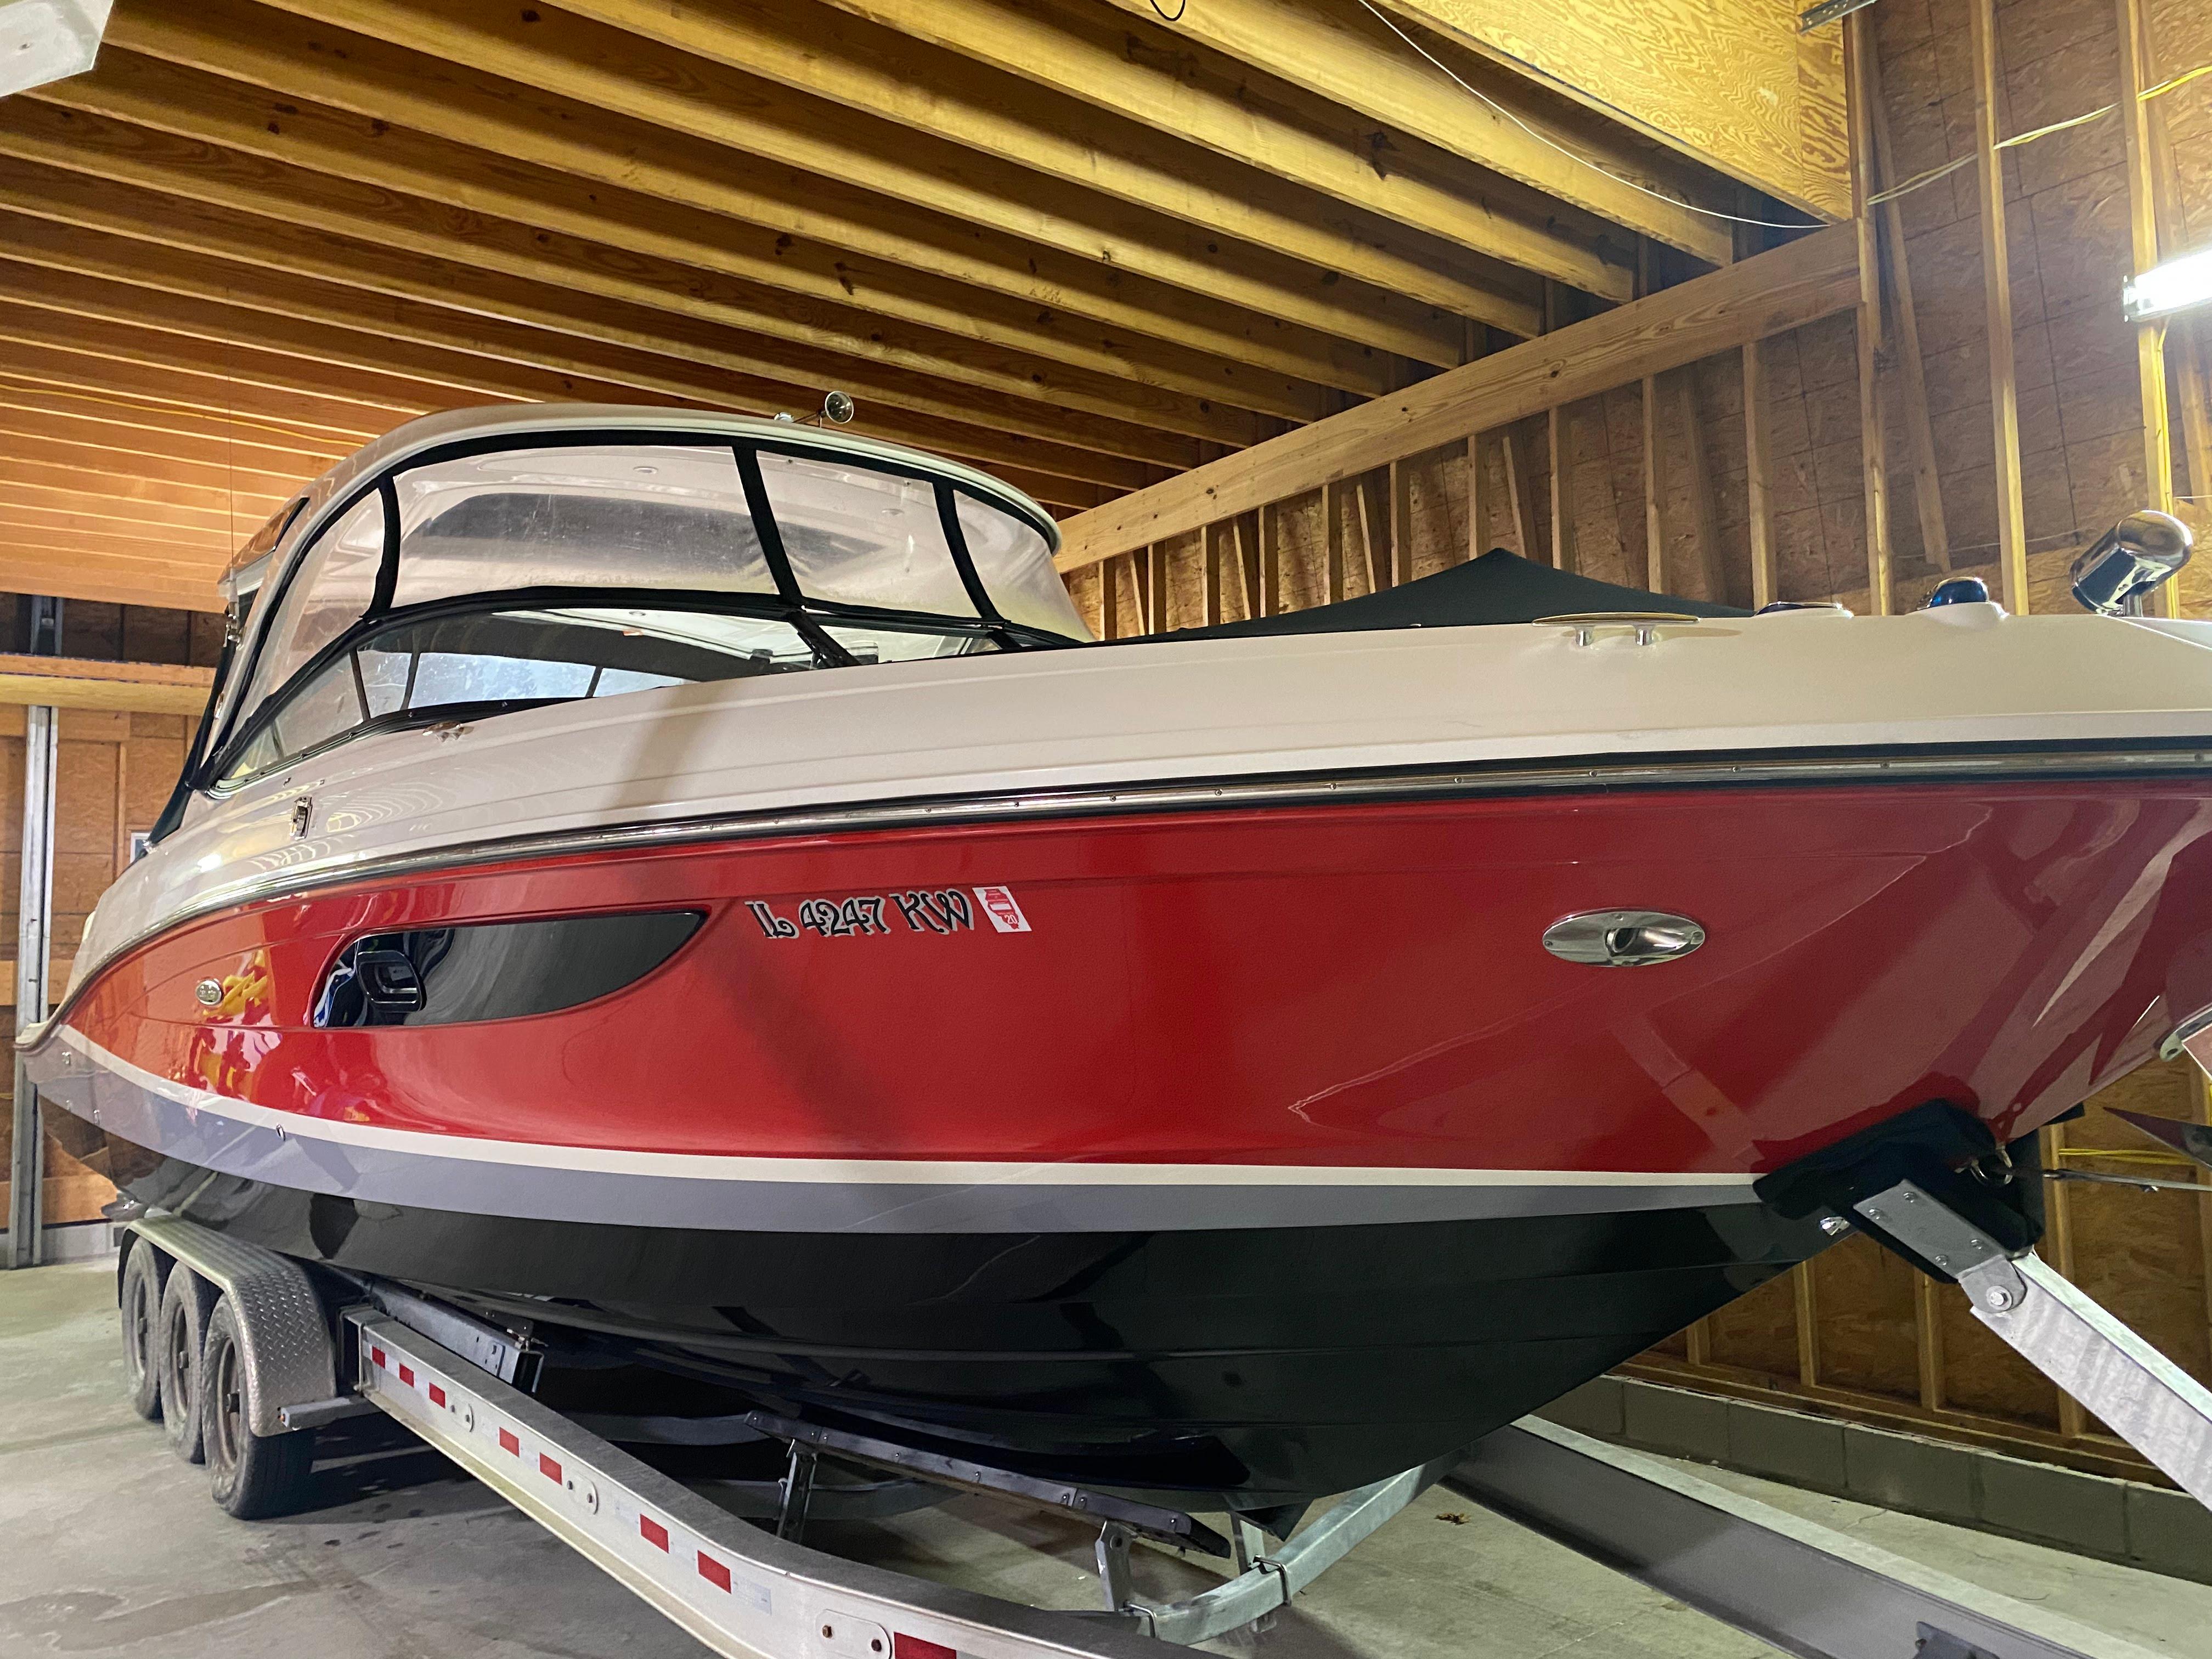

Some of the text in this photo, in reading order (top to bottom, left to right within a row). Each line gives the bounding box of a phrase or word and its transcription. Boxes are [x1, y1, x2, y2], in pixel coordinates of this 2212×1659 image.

[744, 888, 974, 939] IL 4247 KW
[1003, 914, 1018, 924] 20
